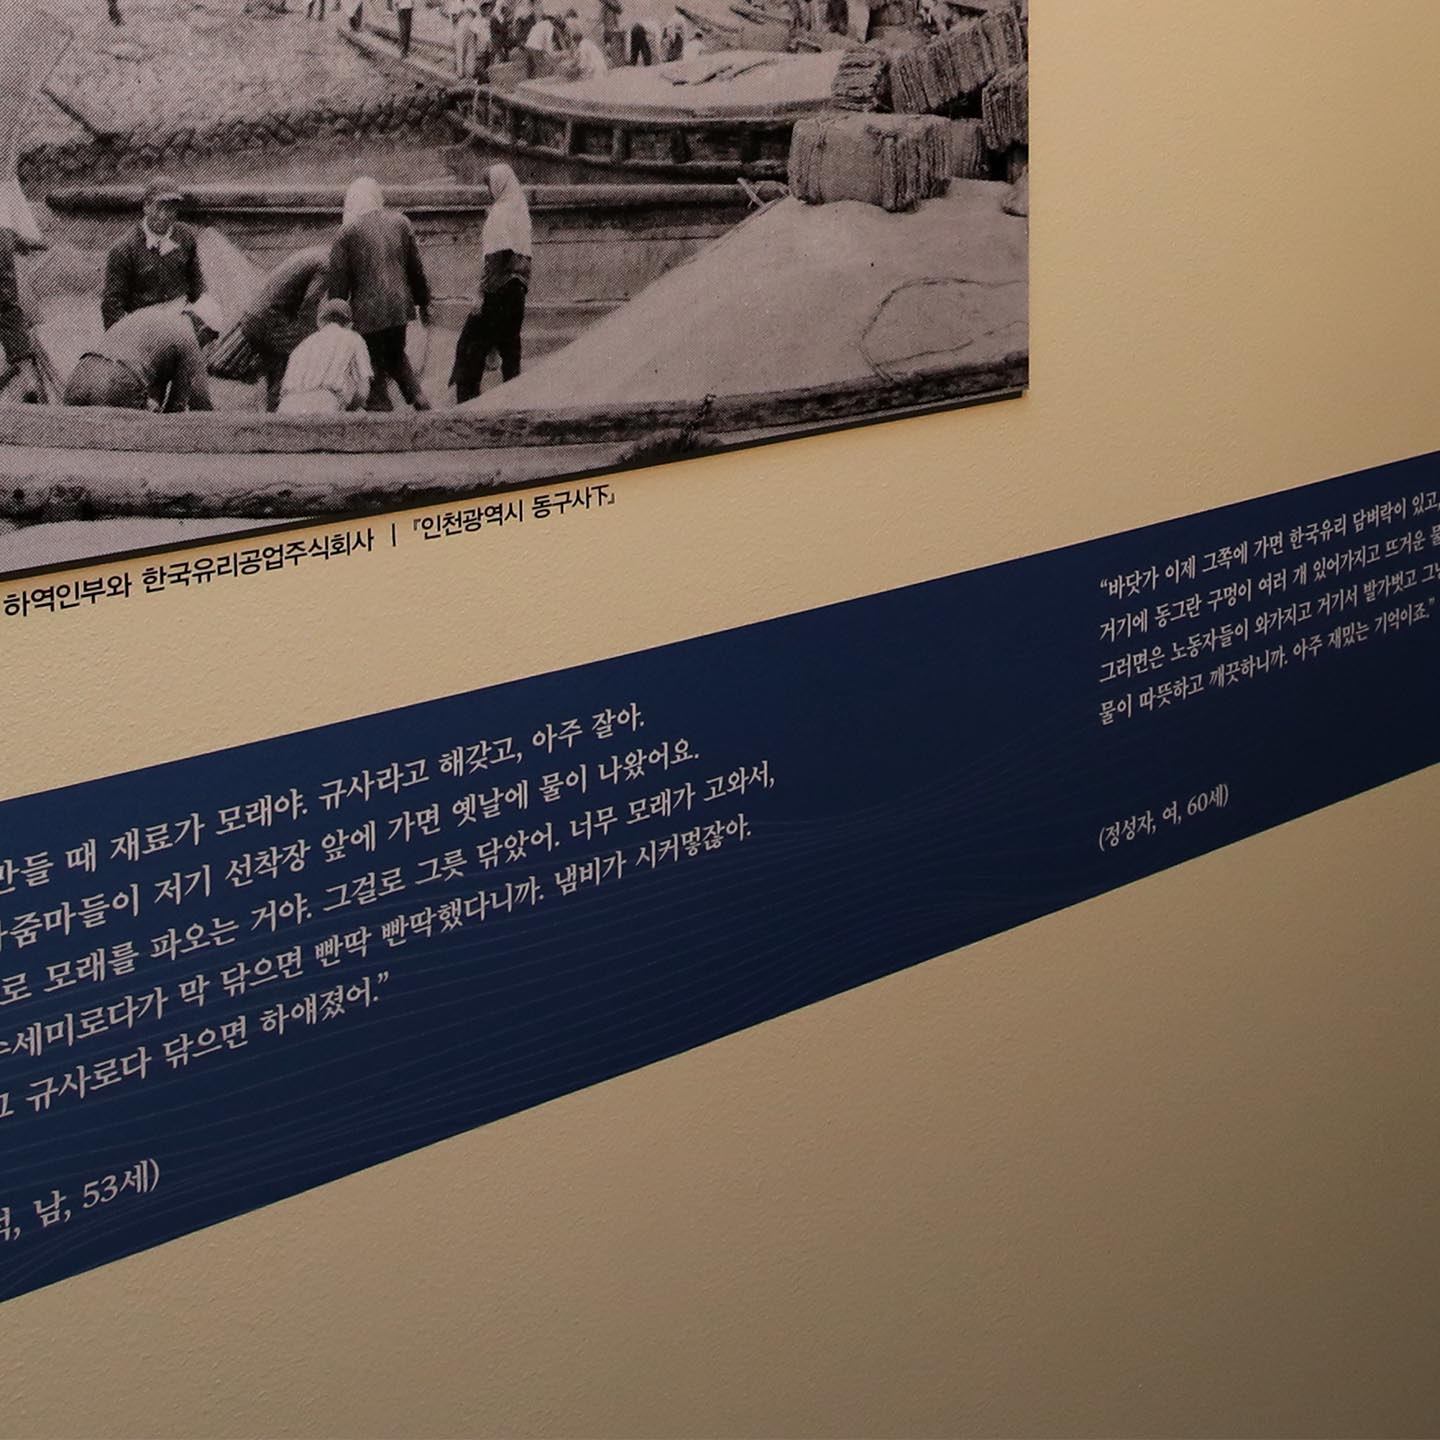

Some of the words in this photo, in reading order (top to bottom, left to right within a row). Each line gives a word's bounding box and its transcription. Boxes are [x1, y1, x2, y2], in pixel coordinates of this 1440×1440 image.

[2, 571, 133, 618] 하역인부와
[141, 527, 375, 594] 한국유리공업주식회사
[1098, 607, 1149, 643] 거기에
[1153, 592, 1204, 629] 동그란
[1206, 577, 1252, 613] 구멍이
[1257, 567, 1287, 597] 여러
[1291, 561, 1308, 586] 개
[1312, 543, 1382, 583] 있어가지고
[1384, 529, 1427, 559] 뜨거운
[1164, 554, 1196, 585] 이제
[1200, 540, 1249, 573] 그쪽에
[1252, 530, 1284, 560] 가면
[1288, 512, 1347, 551] 한국유리
[1351, 496, 1407, 534] 담벼락이
[1098, 645, 1166, 684] 그러면은
[1169, 617, 1249, 662] 노동자들이
[1253, 600, 1313, 637] 와가지고
[1316, 583, 1358, 617] 거기서
[1362, 568, 1418, 604] 발가벗고
[1098, 692, 1133, 726] 물이
[1138, 673, 1205, 712] 따뜻하고
[1208, 644, 1289, 689] 깨끗하니까.
[1292, 633, 1324, 662] 아주
[1327, 620, 1371, 650] 재밌는
[64, 838, 97, 873] 때
[109, 812, 206, 862] 재료가
[215, 787, 309, 836] 모래야.
[317, 758, 430, 812] 규사라고
[437, 736, 523, 777] 해갖고,
[531, 717, 584, 754] 아주
[591, 701, 645, 740] 잘아.
[153, 863, 211, 906] 저기
[224, 838, 312, 888] 선착장
[320, 819, 377, 863] 앞에
[387, 802, 441, 843] 가면
[451, 779, 529, 828] 옛날에
[538, 763, 587, 803] 물이
[597, 737, 700, 785] 나왔어요.
[1098, 809, 1157, 852] (정성자,
[1161, 800, 1183, 825] 여,
[1186, 783, 1230, 816] 60세)
[42, 940, 140, 993] 모래를
[149, 917, 240, 961] 파오는
[250, 892, 313, 933] 거야.
[322, 866, 407, 912] 그걸로
[414, 848, 468, 886] 그릇
[475, 821, 561, 871] 닦았어.
[568, 805, 619, 841] 너무
[625, 781, 697, 825] 모래가
[702, 759, 775, 802] 고와서,
[177, 973, 211, 1008] 막
[219, 945, 305, 998] 닦으면
[314, 925, 373, 968] 빤딱
[380, 875, 545, 948] 빤딱했다니까.
[553, 849, 628, 897] 냄비가
[634, 812, 752, 870] 시커멓잖아.
[25, 1046, 153, 1113] 규사로다
[161, 1014, 249, 1070] 닦으면
[32, 1189, 72, 1228] 남,
[82, 1157, 160, 1209] 53세)
